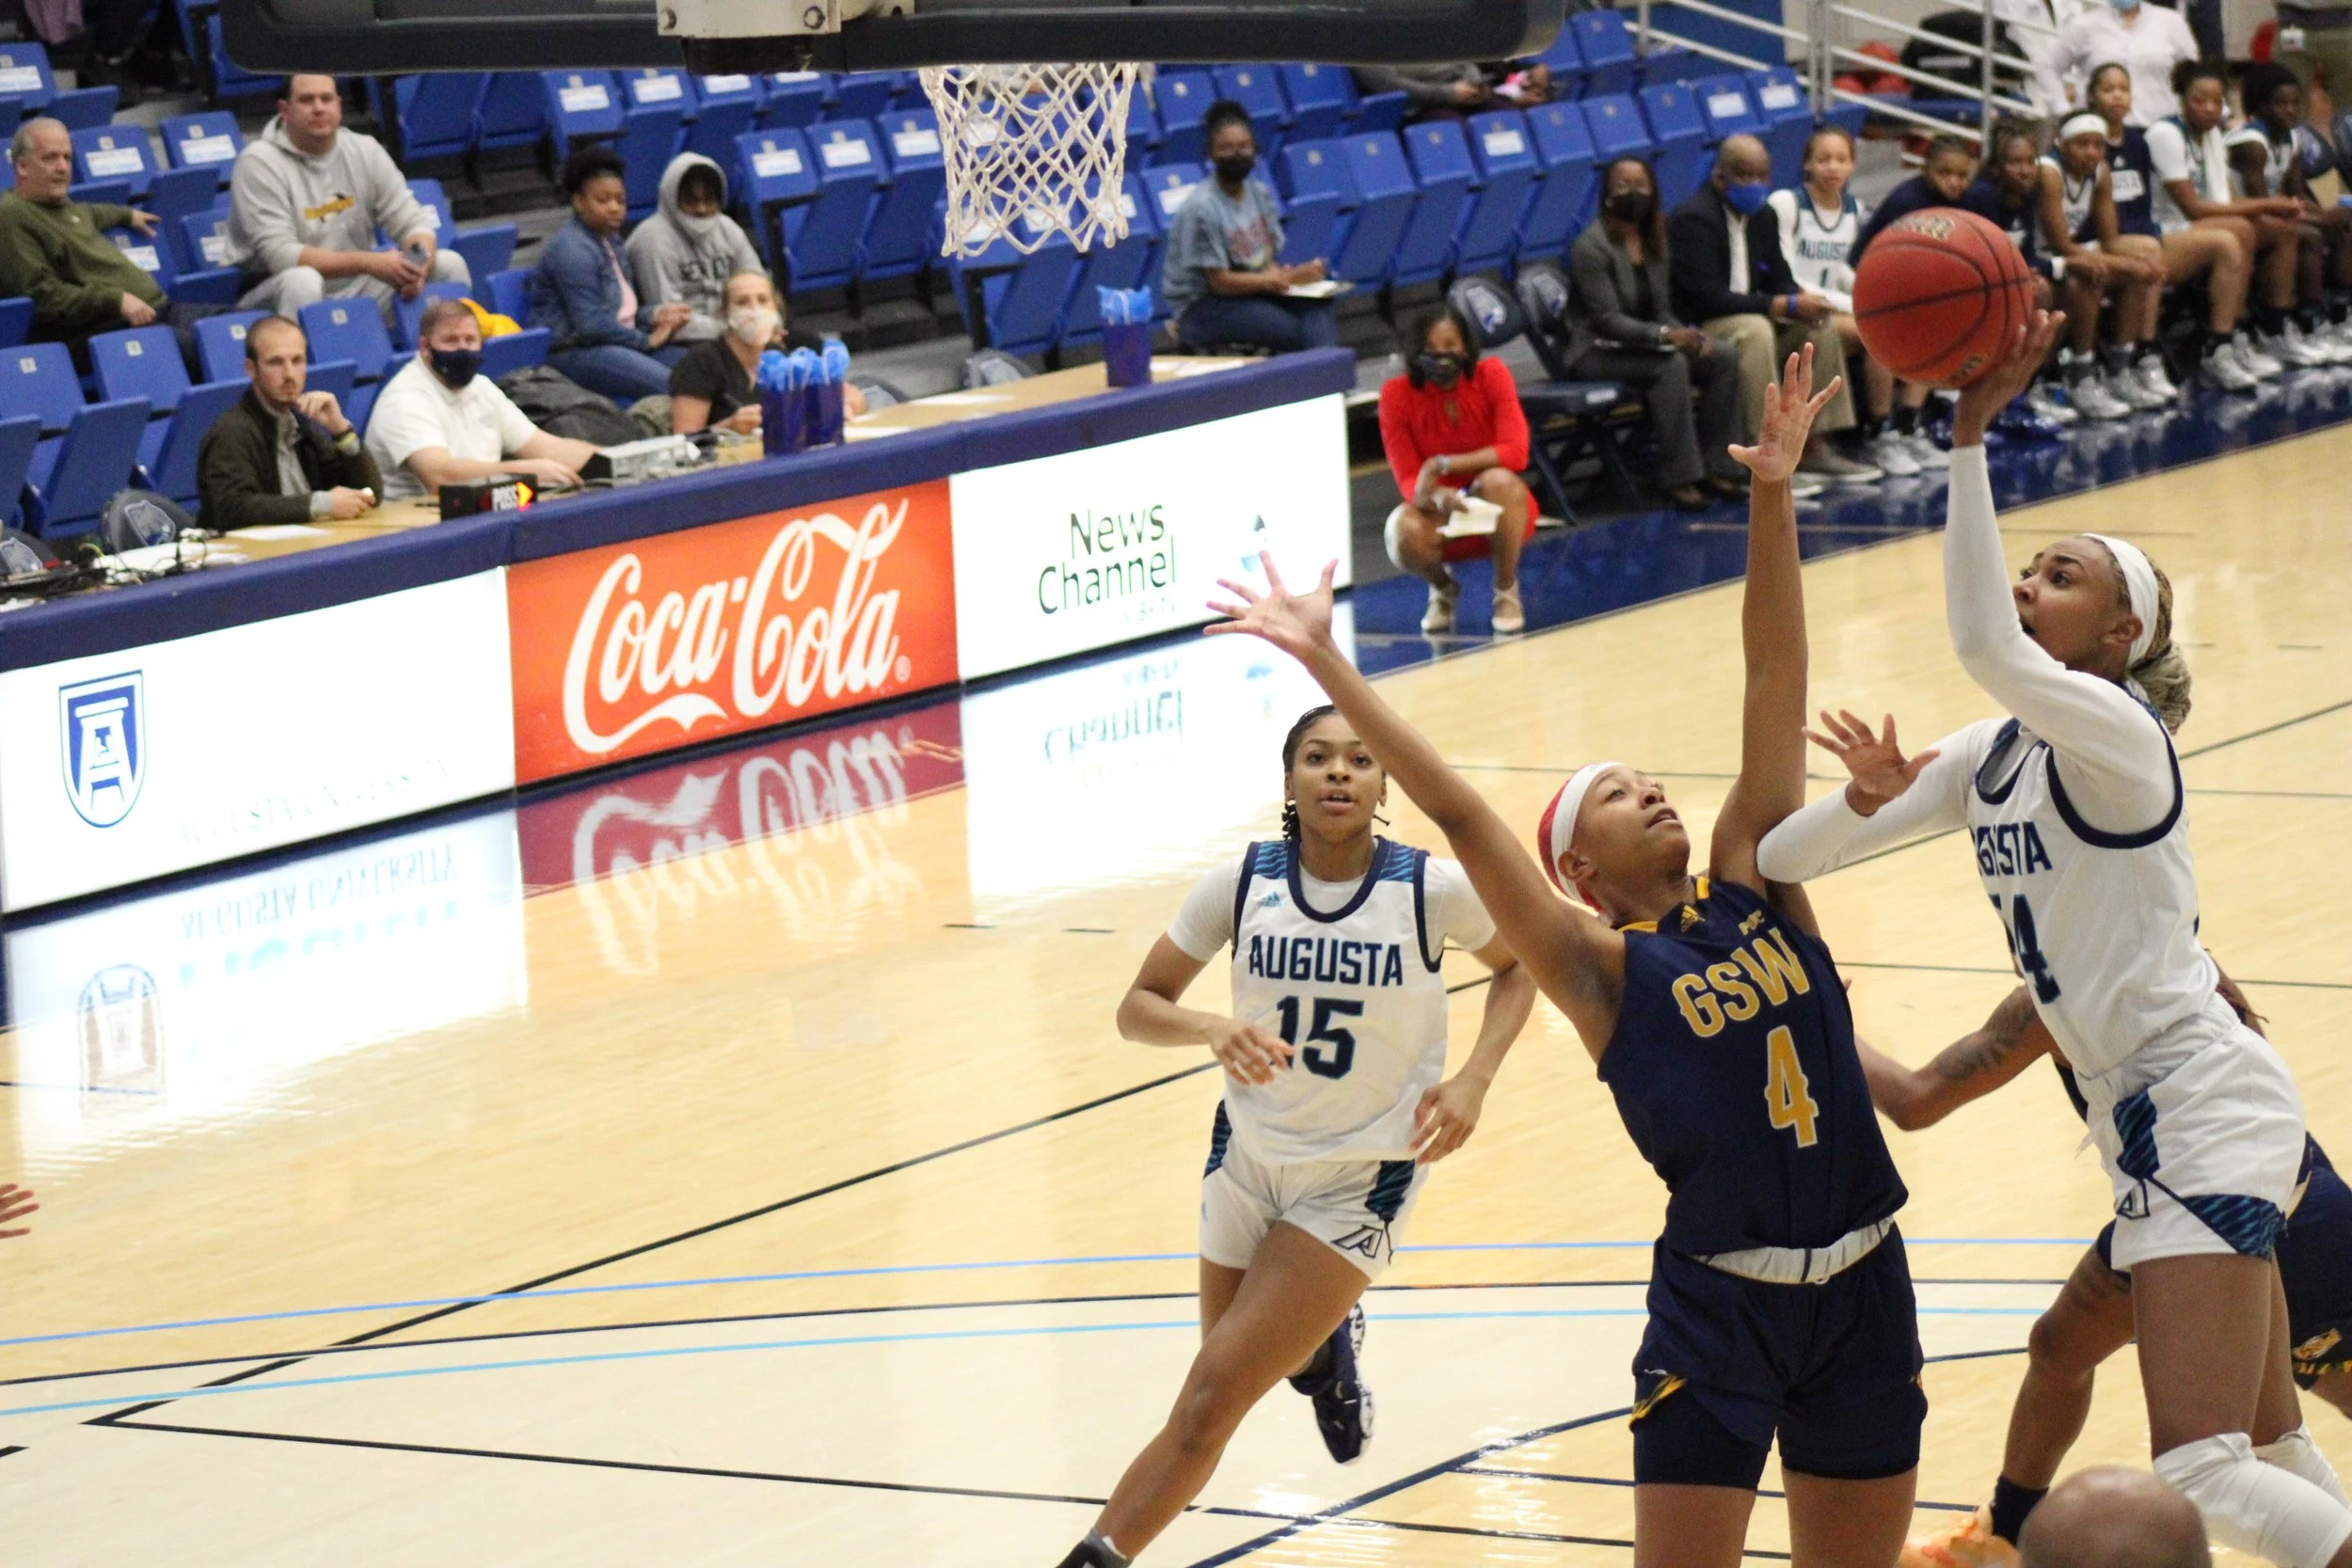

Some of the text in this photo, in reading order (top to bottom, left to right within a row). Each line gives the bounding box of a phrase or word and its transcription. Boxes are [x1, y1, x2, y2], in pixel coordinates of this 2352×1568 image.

[1070, 503, 1165, 560] News
[1038, 534, 1176, 616] Channel
[562, 498, 909, 753] Coca-Cola
[1248, 935, 1403, 987] AUGUSTA
[1671, 927, 1810, 1037] GSW
[1276, 994, 1365, 1080] 15
[1764, 1024, 1820, 1148] 4
